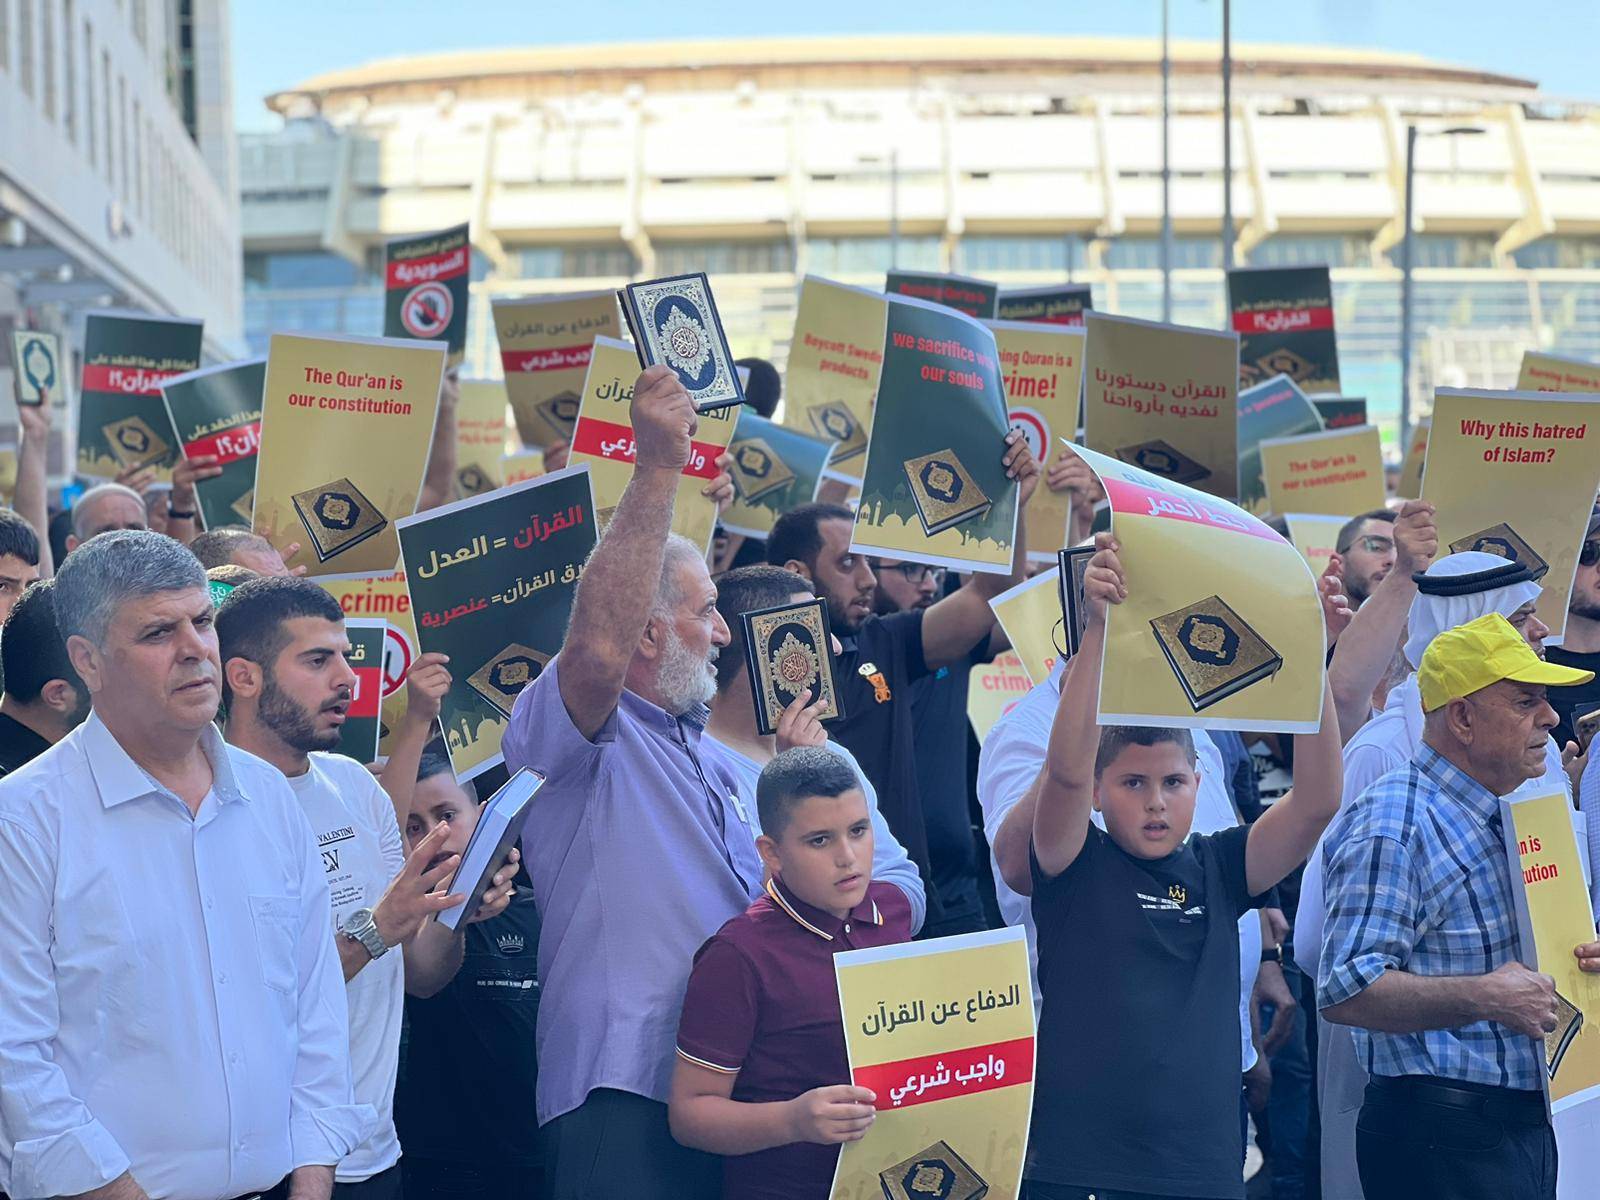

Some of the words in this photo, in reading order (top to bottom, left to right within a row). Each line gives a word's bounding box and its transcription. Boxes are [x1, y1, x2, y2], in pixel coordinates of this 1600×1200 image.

[918, 337, 974, 362] sacrifice
[1022, 351, 1053, 365] Quran
[304, 366, 332, 385] The
[336, 371, 386, 390] Qur'an
[390, 375, 403, 391] is
[921, 365, 944, 382] our
[948, 370, 985, 391] souls
[1095, 367, 1167, 392] دستورنا
[1171, 379, 1226, 400] القرآن
[288, 393, 316, 408] our
[318, 396, 412, 415] constitution
[1103, 390, 1165, 416] بأرواحنا
[1169, 404, 1218, 418] نفديه
[1461, 419, 1496, 440] Why
[1499, 421, 1529, 438] this
[1532, 422, 1586, 439] hatred
[1483, 447, 1501, 462] of
[1502, 447, 1556, 463] Islam?
[513, 504, 583, 549] القرآن
[493, 536, 507, 549] =
[418, 535, 488, 579] العدل
[421, 596, 489, 628] عنصرية
[1528, 835, 1541, 853] is
[931, 1001, 961, 1025] عن
[966, 984, 1020, 1023] الدفاع
[862, 1000, 925, 1036] القرآن
[955, 1054, 1006, 1086] واجب
[890, 1060, 951, 1106] شرعي
